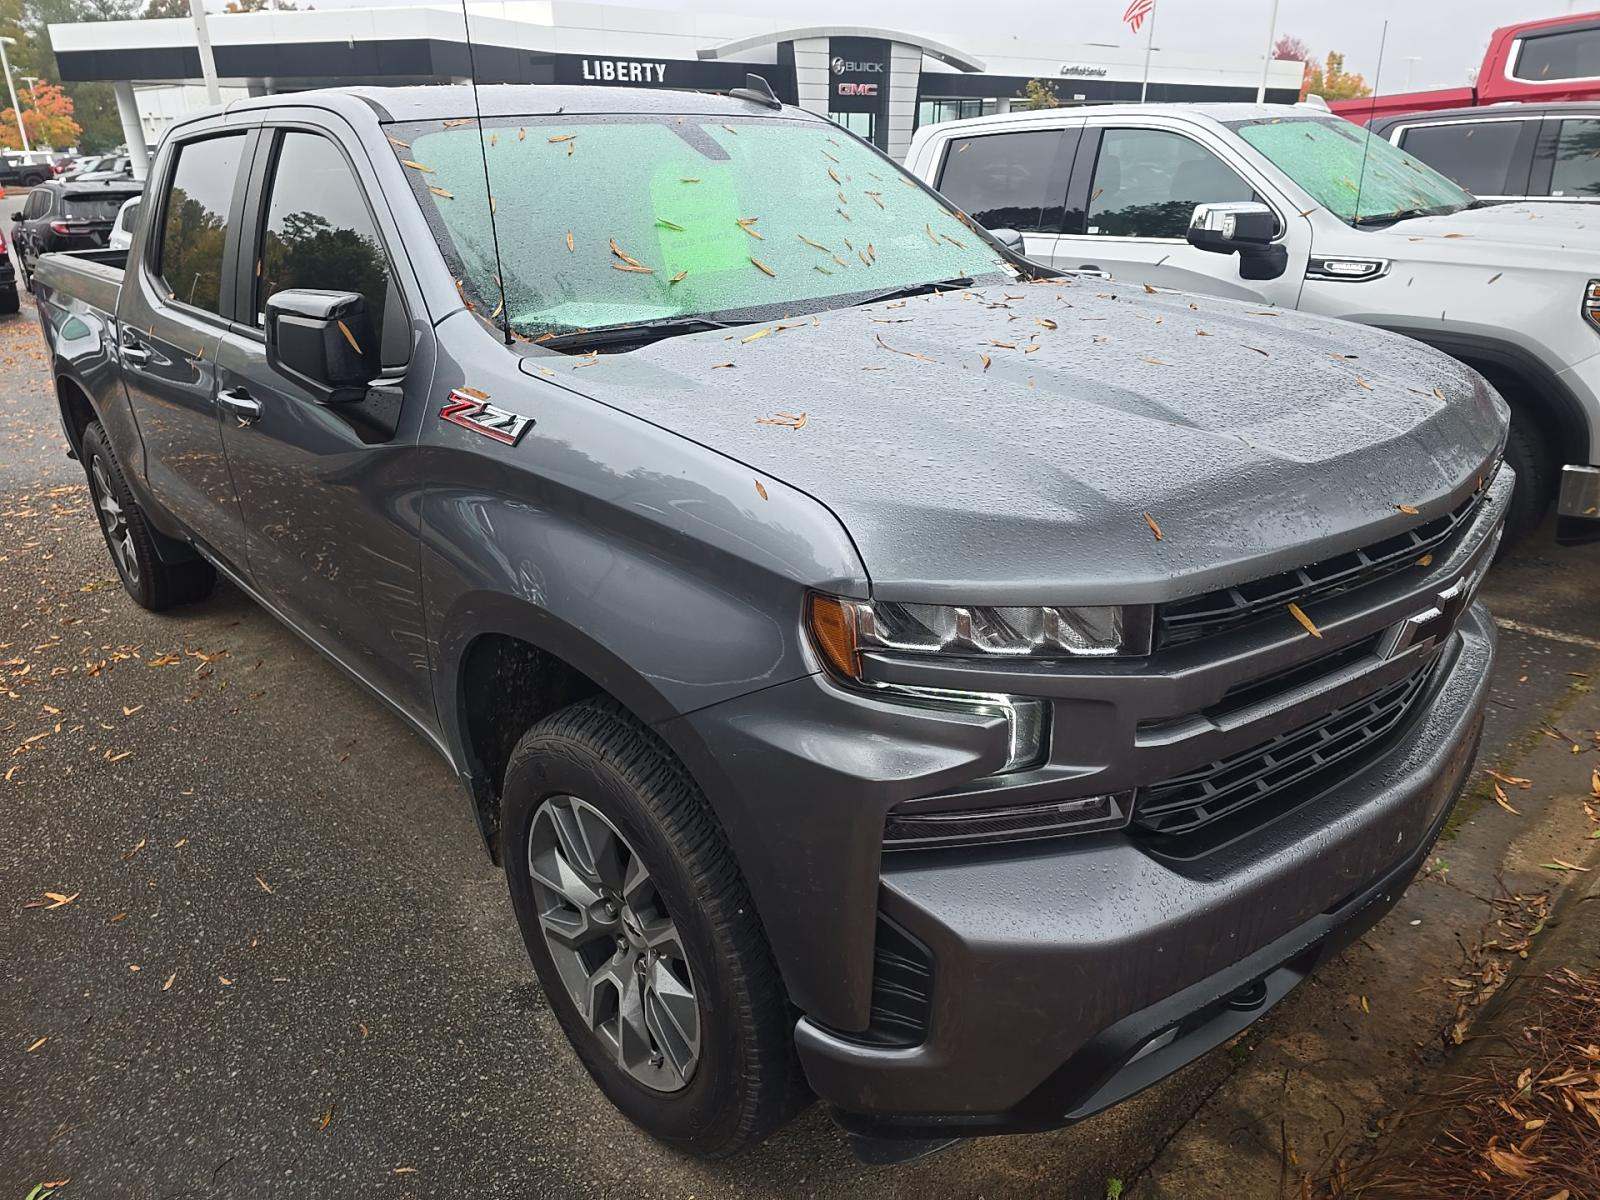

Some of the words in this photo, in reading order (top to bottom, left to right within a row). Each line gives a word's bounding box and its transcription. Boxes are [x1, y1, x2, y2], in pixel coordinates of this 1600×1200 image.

[582, 60, 666, 82] LIBERTY
[845, 61, 883, 73] BUICK
[838, 83, 878, 95] GMC
[439, 389, 536, 448] Z71
